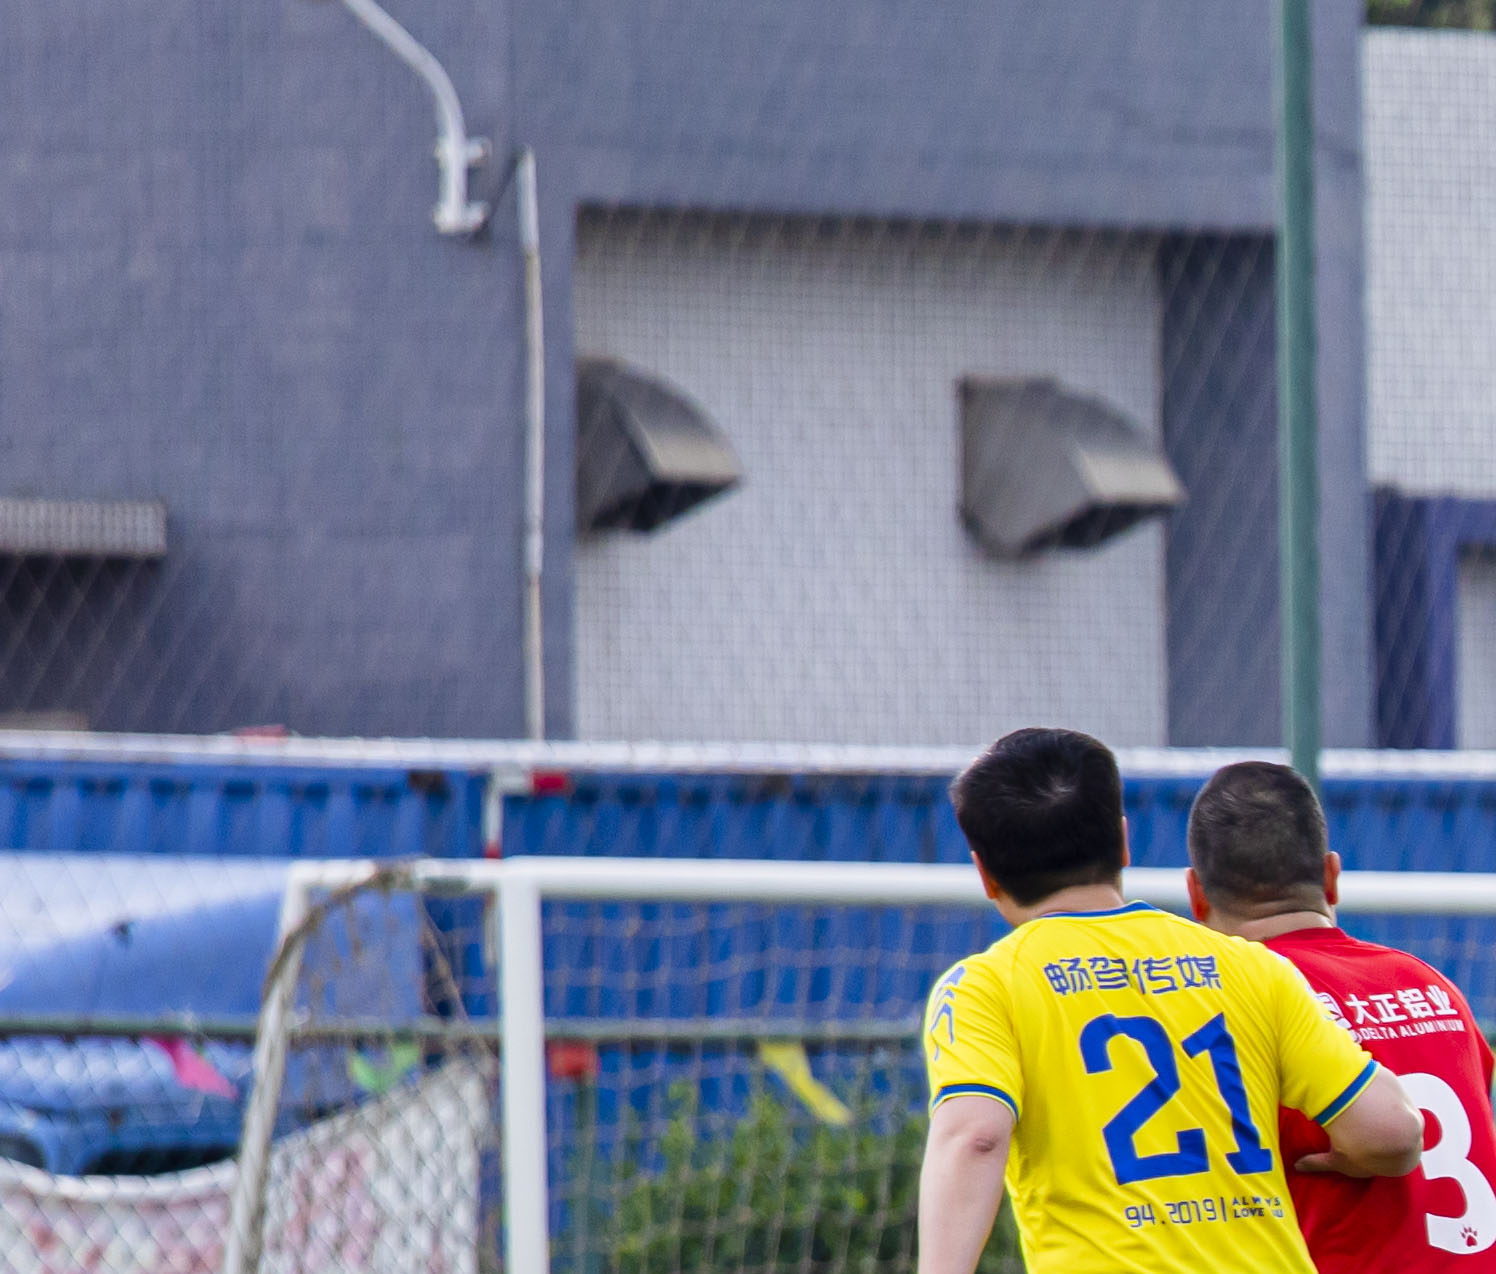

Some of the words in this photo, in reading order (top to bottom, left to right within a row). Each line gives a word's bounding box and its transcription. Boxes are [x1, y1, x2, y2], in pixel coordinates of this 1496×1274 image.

[1345, 984, 1458, 1025] 大正铝业
[1079, 1012, 1273, 1186] 21
